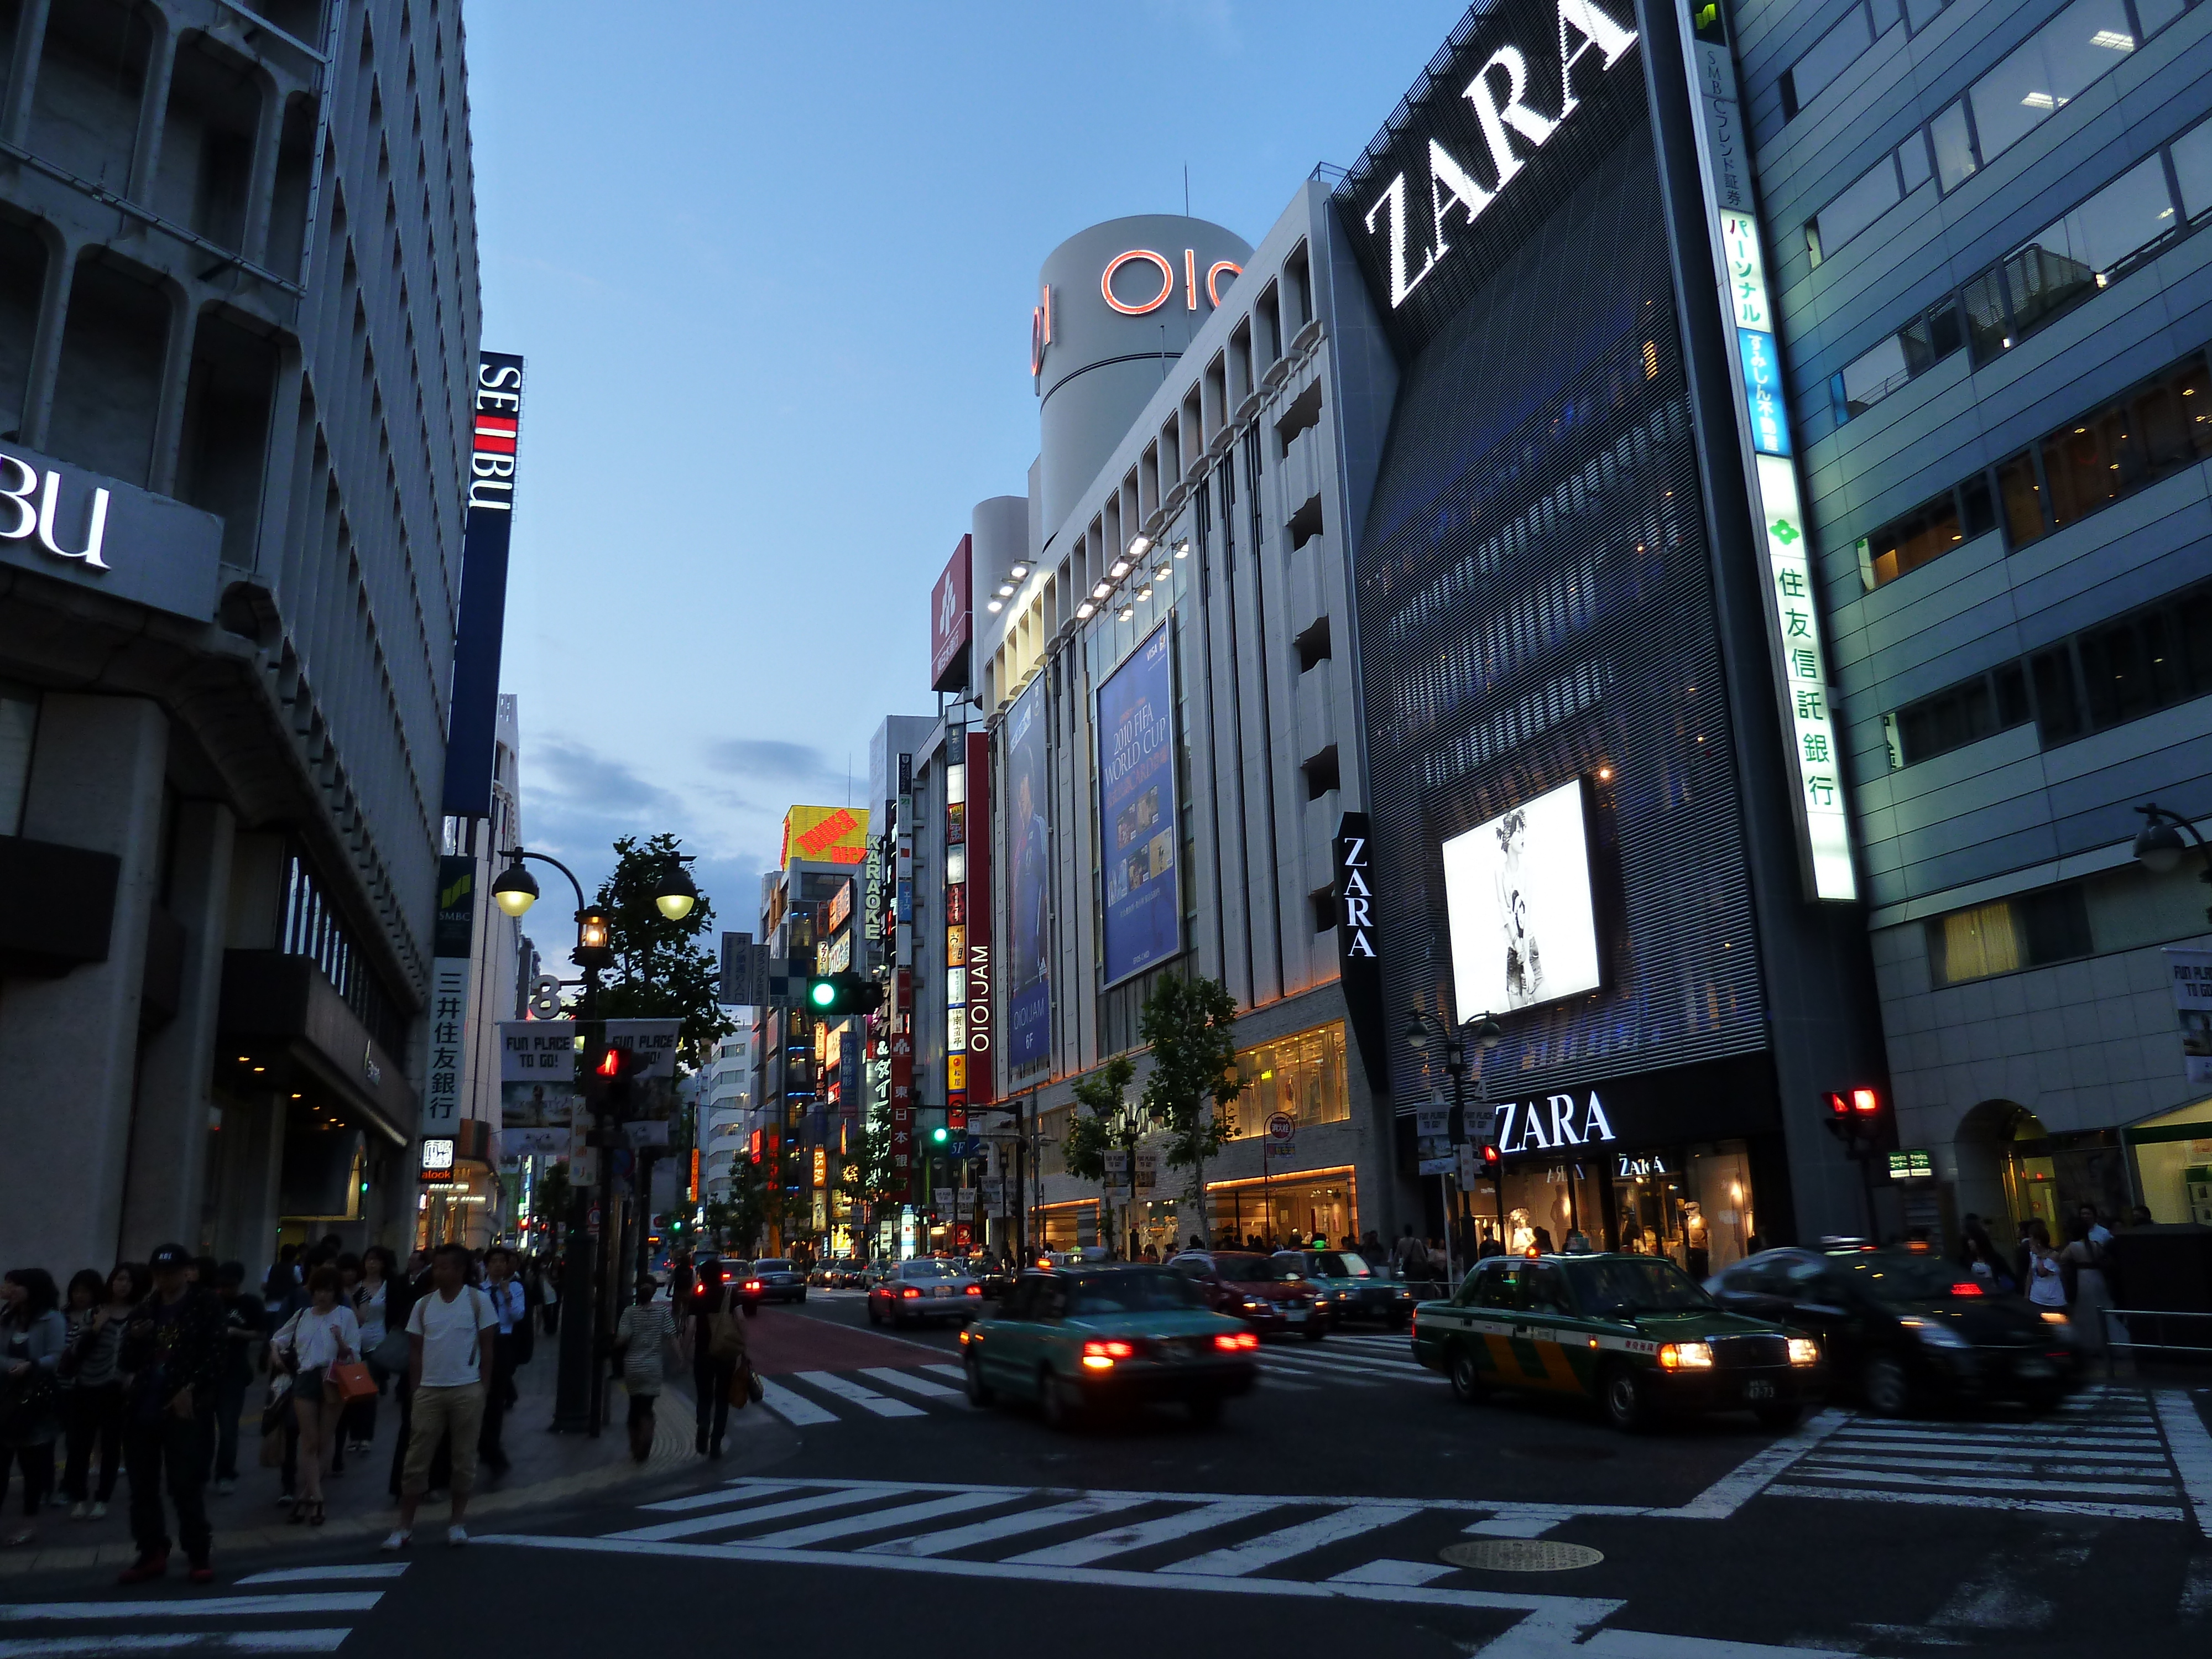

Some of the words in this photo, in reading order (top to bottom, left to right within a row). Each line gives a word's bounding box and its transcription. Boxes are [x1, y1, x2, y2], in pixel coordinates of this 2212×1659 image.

[1707, 51, 1741, 206] SMBCフレンド証券
[1364, 0, 1638, 309] ZARA
[1729, 219, 1761, 323] パーソナル
[1747, 335, 1779, 452] すみしん不動産
[469, 363, 521, 510] SEIBU
[1779, 567, 1834, 806] 住友信託銀行
[1104, 741, 1140, 787] WORLD
[1143, 717, 1166, 754] CUP
[1114, 720, 1133, 755] 2010
[1134, 702, 1154, 737] FIFA
[796, 809, 858, 856] TOWER
[865, 834, 881, 939] KARAOKE
[1343, 837, 1377, 957] ZARA
[439, 911, 471, 922] SMBC
[529, 974, 561, 1019] 3
[2174, 966, 2190, 979] FUN
[2185, 983, 2197, 997] TO
[971, 944, 990, 1052] OIOIJAM
[429, 972, 461, 1119] 三井住友銀行
[507, 1036, 528, 1050] FUN
[534, 1036, 570, 1050] PLACE
[520, 1054, 534, 1067] TO
[540, 1053, 558, 1067] GO!
[613, 1036, 633, 1048] FUN
[639, 1035, 674, 1048] PLACE
[1025, 1032, 1034, 1050] 6F
[1474, 1079, 1490, 1102] 4
[1271, 1123, 1290, 1134] 消火栓
[1495, 1089, 1617, 1154] ZARA
[952, 1142, 966, 1154] 5F
[421, 1170, 451, 1179] alook
